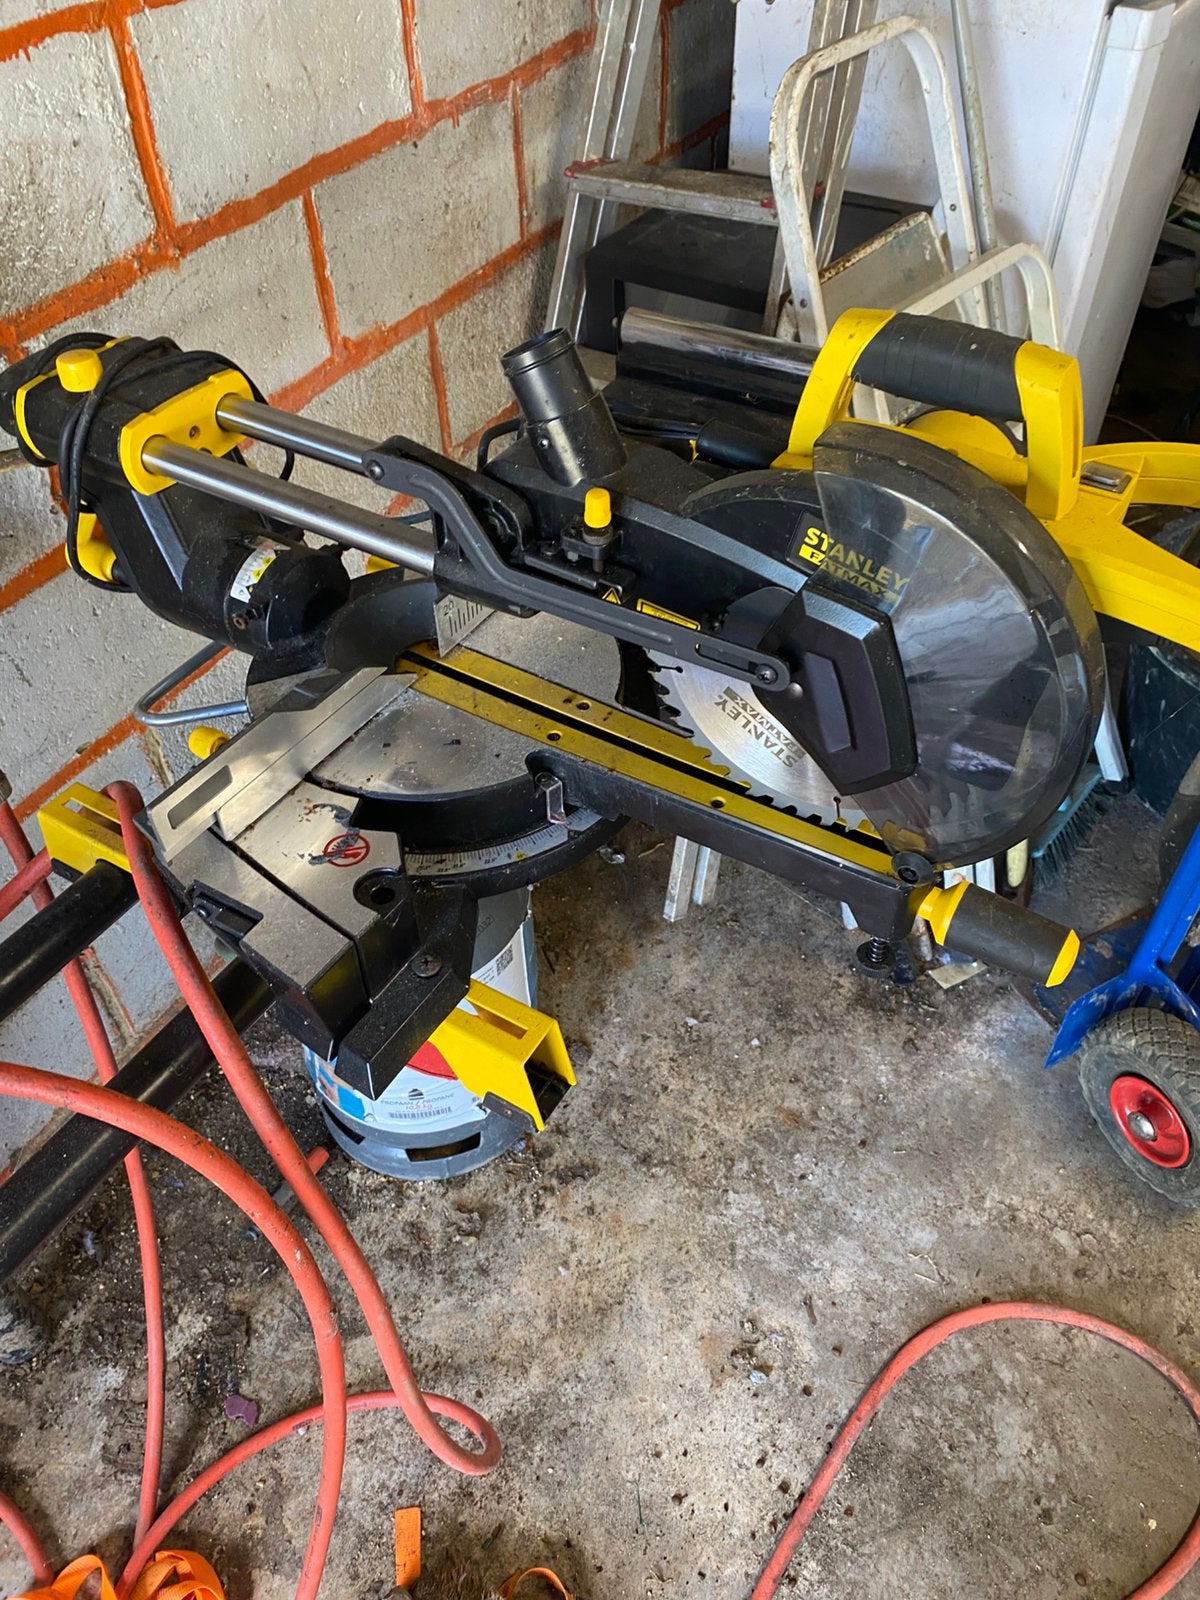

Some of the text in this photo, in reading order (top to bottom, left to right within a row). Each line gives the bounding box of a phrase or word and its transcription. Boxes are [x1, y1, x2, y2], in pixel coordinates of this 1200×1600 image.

[804, 527, 909, 590] STANLEY
[810, 551, 888, 598] FATMAX
[443, 600, 455, 615] 20
[714, 696, 798, 769] STANLEY
[735, 696, 798, 752] FATMAX
